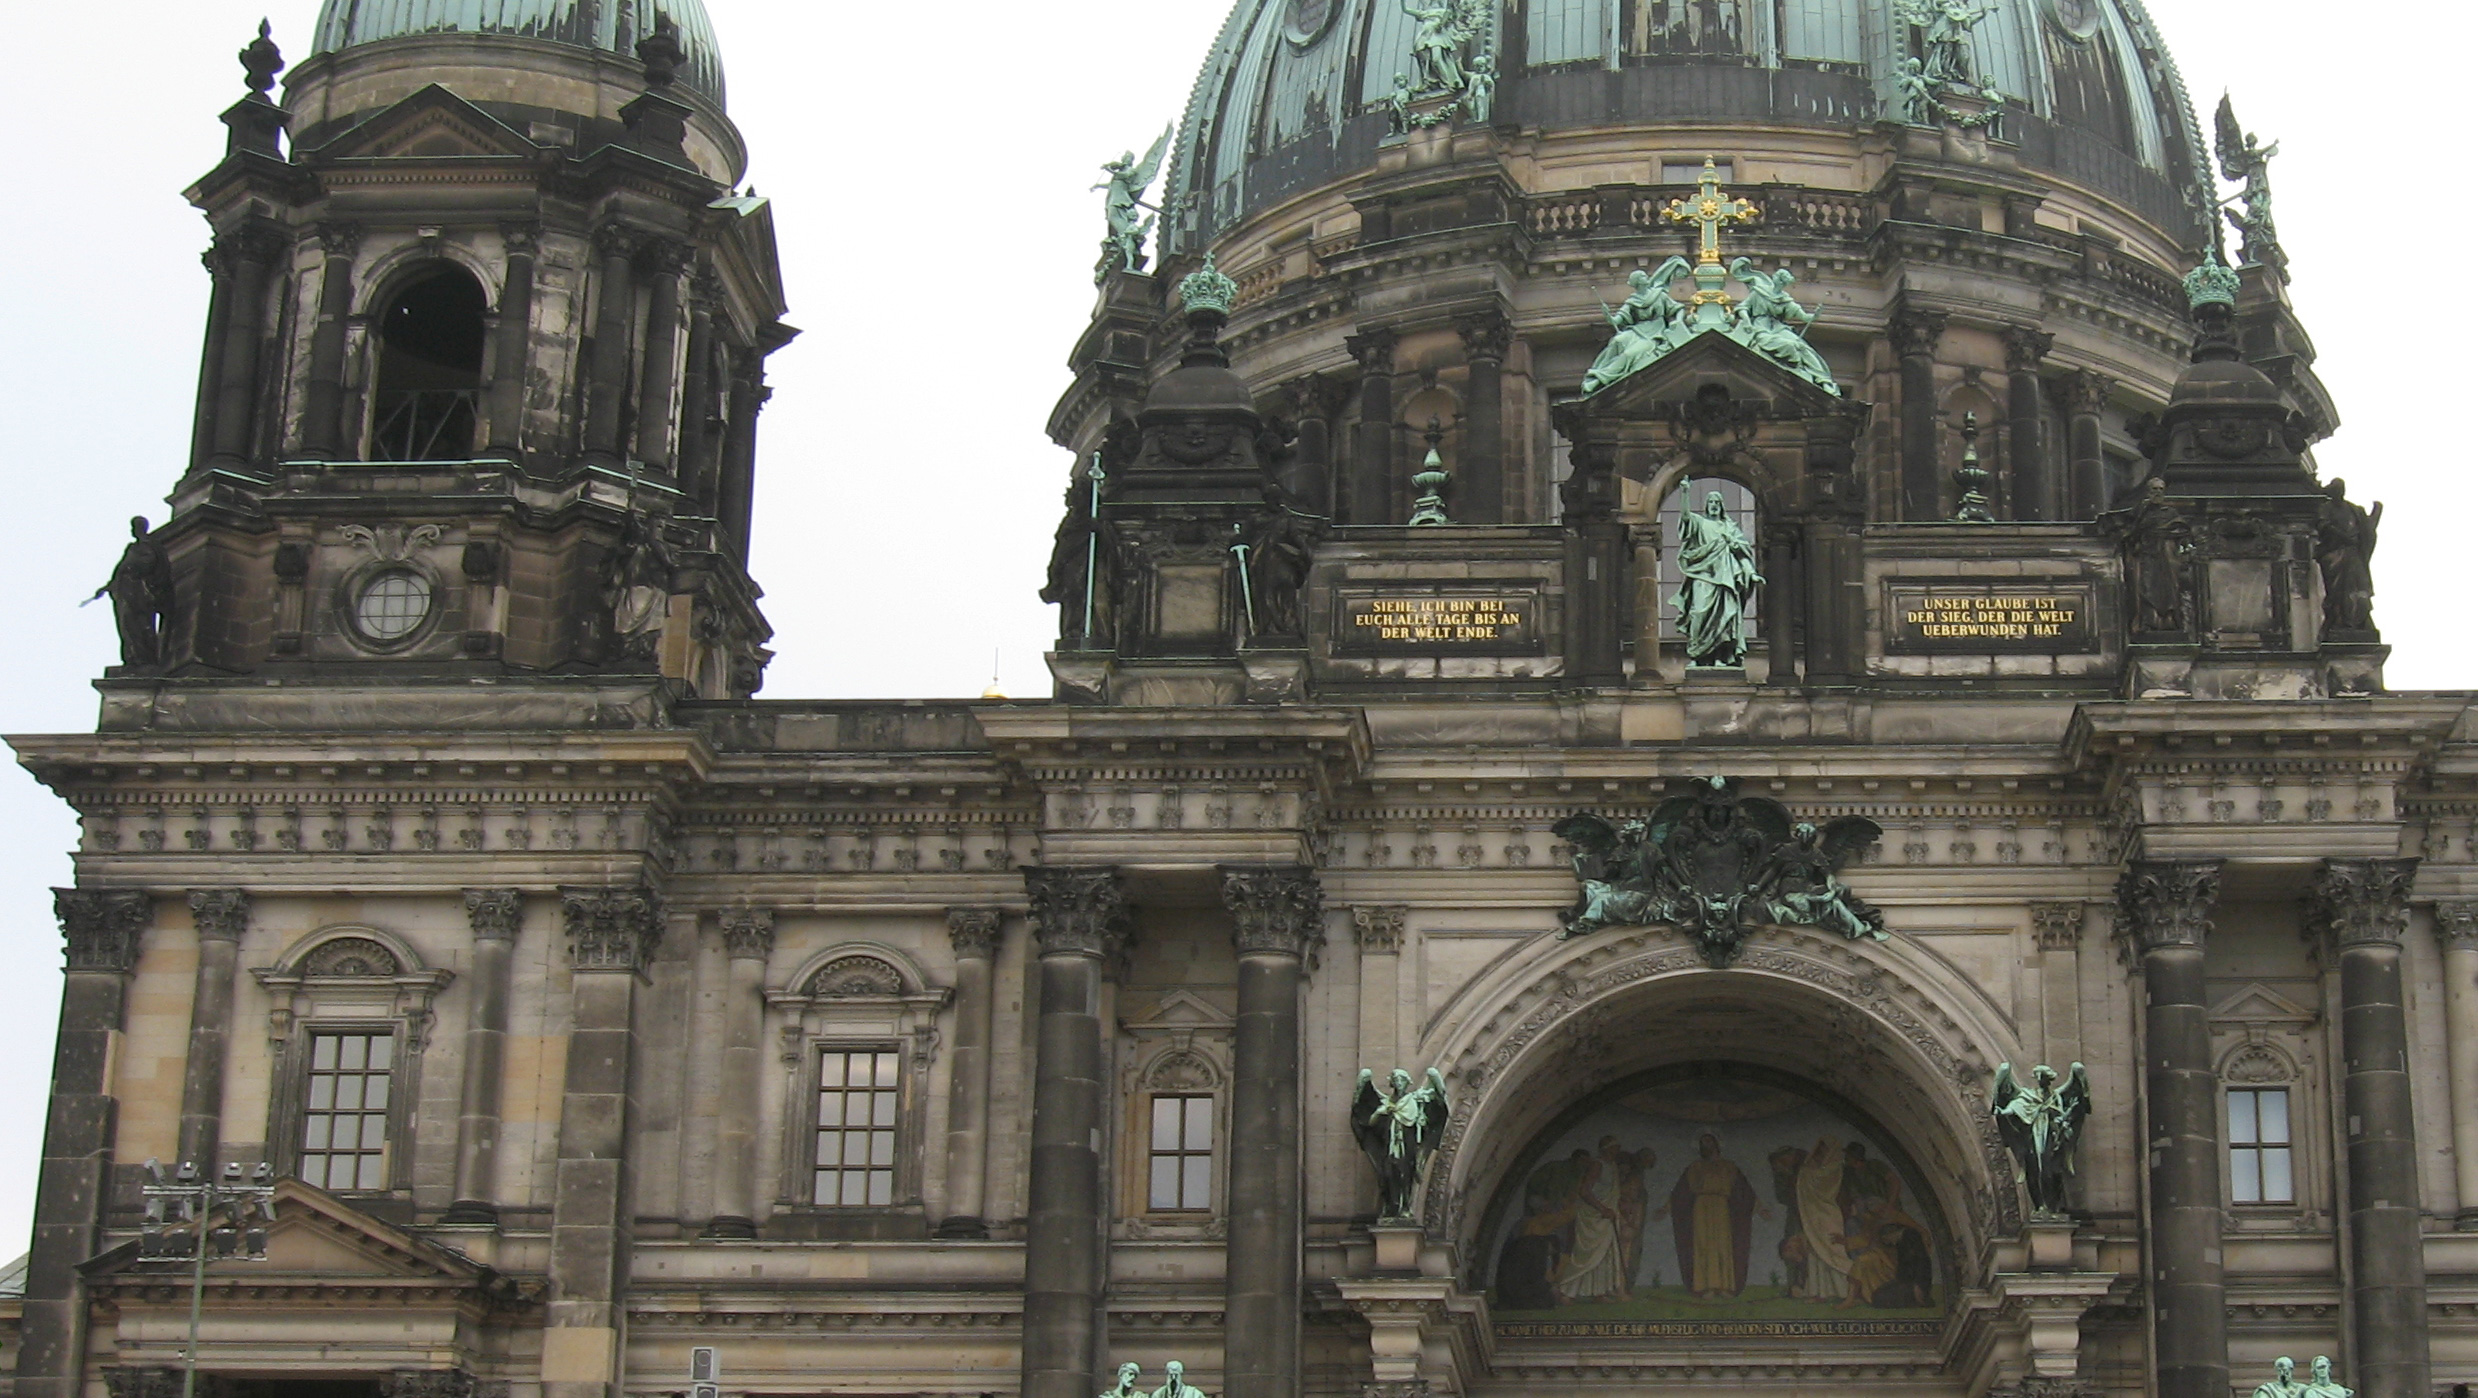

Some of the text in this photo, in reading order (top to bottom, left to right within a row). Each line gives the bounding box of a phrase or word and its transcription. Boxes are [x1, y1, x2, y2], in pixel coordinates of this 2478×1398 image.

[1421, 600, 1445, 612] ICH
[1450, 600, 1474, 612] BIN
[1480, 600, 1503, 612] BEI
[1924, 599, 2056, 609] UNSER GLAUBE IST
[1356, 614, 1520, 625] EUCH ALLE TAGE BIS AN
[1908, 611, 1935, 623] DER
[1979, 611, 2005, 623] DER
[2011, 611, 2034, 623] DIE
[2038, 611, 2074, 623] WELT
[1382, 627, 1498, 639] DER WELT ENDE.
[1923, 624, 2062, 636] UEBERWUNDEN HAT.
